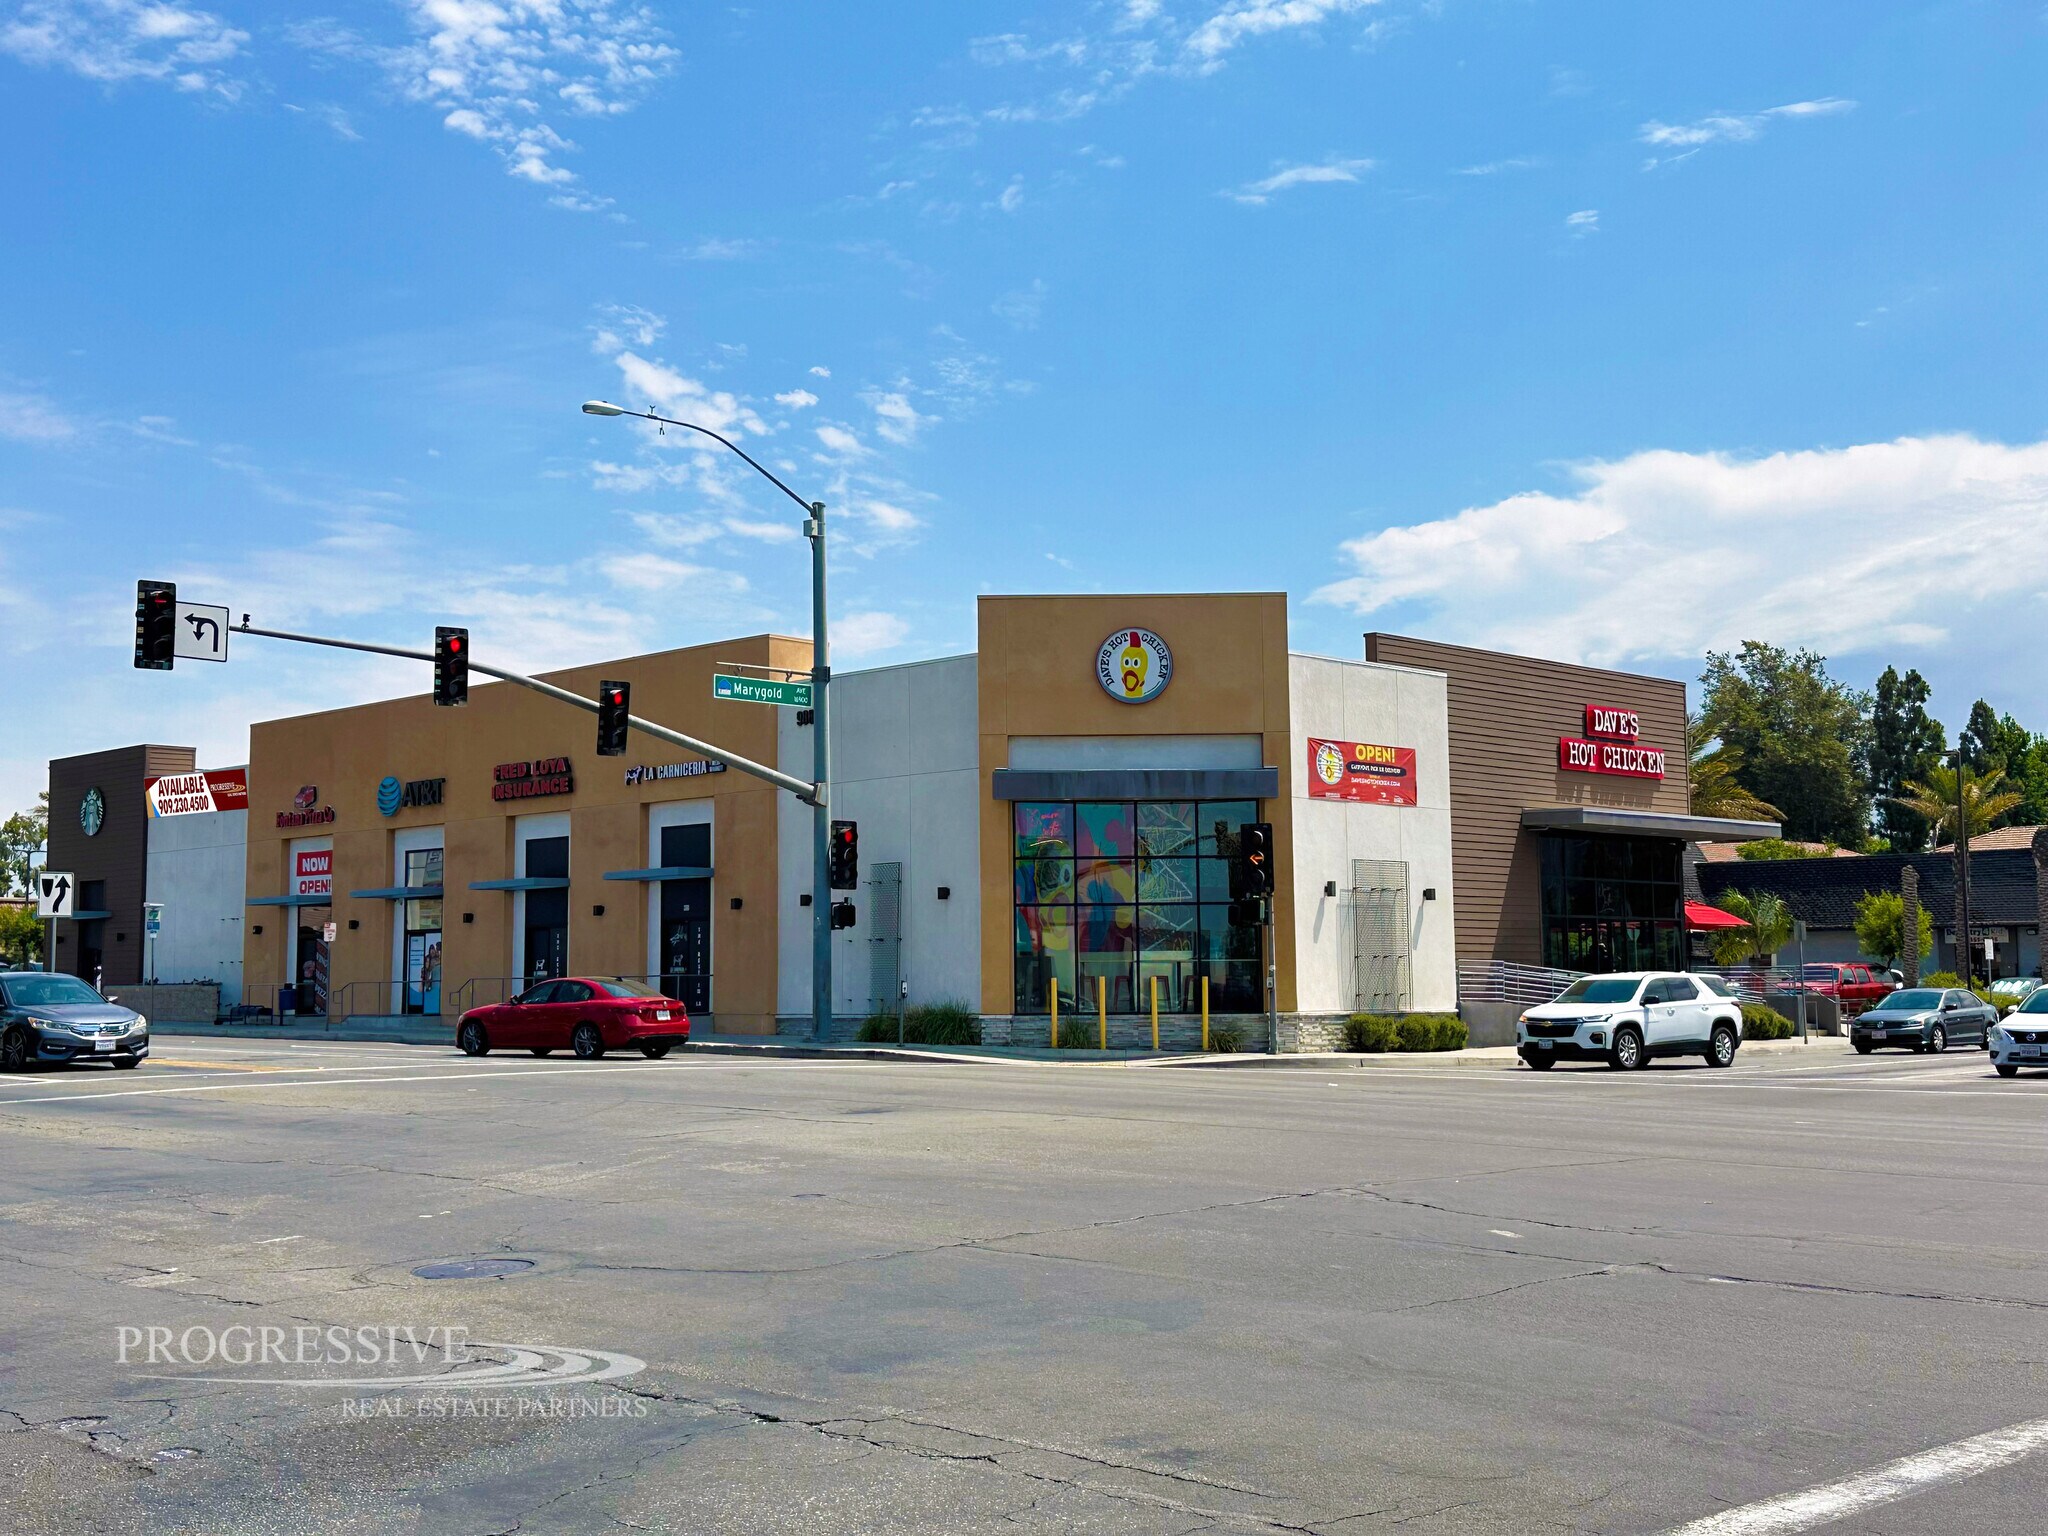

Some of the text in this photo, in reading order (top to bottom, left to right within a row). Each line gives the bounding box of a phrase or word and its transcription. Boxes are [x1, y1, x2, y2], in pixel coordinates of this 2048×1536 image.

[1100, 632, 1169, 687] DAVE'S HOT CHICKEN
[733, 682, 782, 700] Marygold
[1594, 709, 1639, 736] DAVE'S
[1355, 744, 1396, 763] OPEN!
[1568, 742, 1665, 775] HOT CHICKEN
[494, 757, 569, 780] FRED LOYA
[643, 766, 655, 781] LA
[657, 760, 708, 779] CARNICERIA
[158, 775, 205, 797] AVAILABLE
[402, 777, 446, 808] AT&T
[491, 777, 571, 801] INSURANCE
[158, 795, 209, 814] 909.230.4500
[302, 856, 329, 873] NOW
[299, 879, 331, 894] OPEN!
